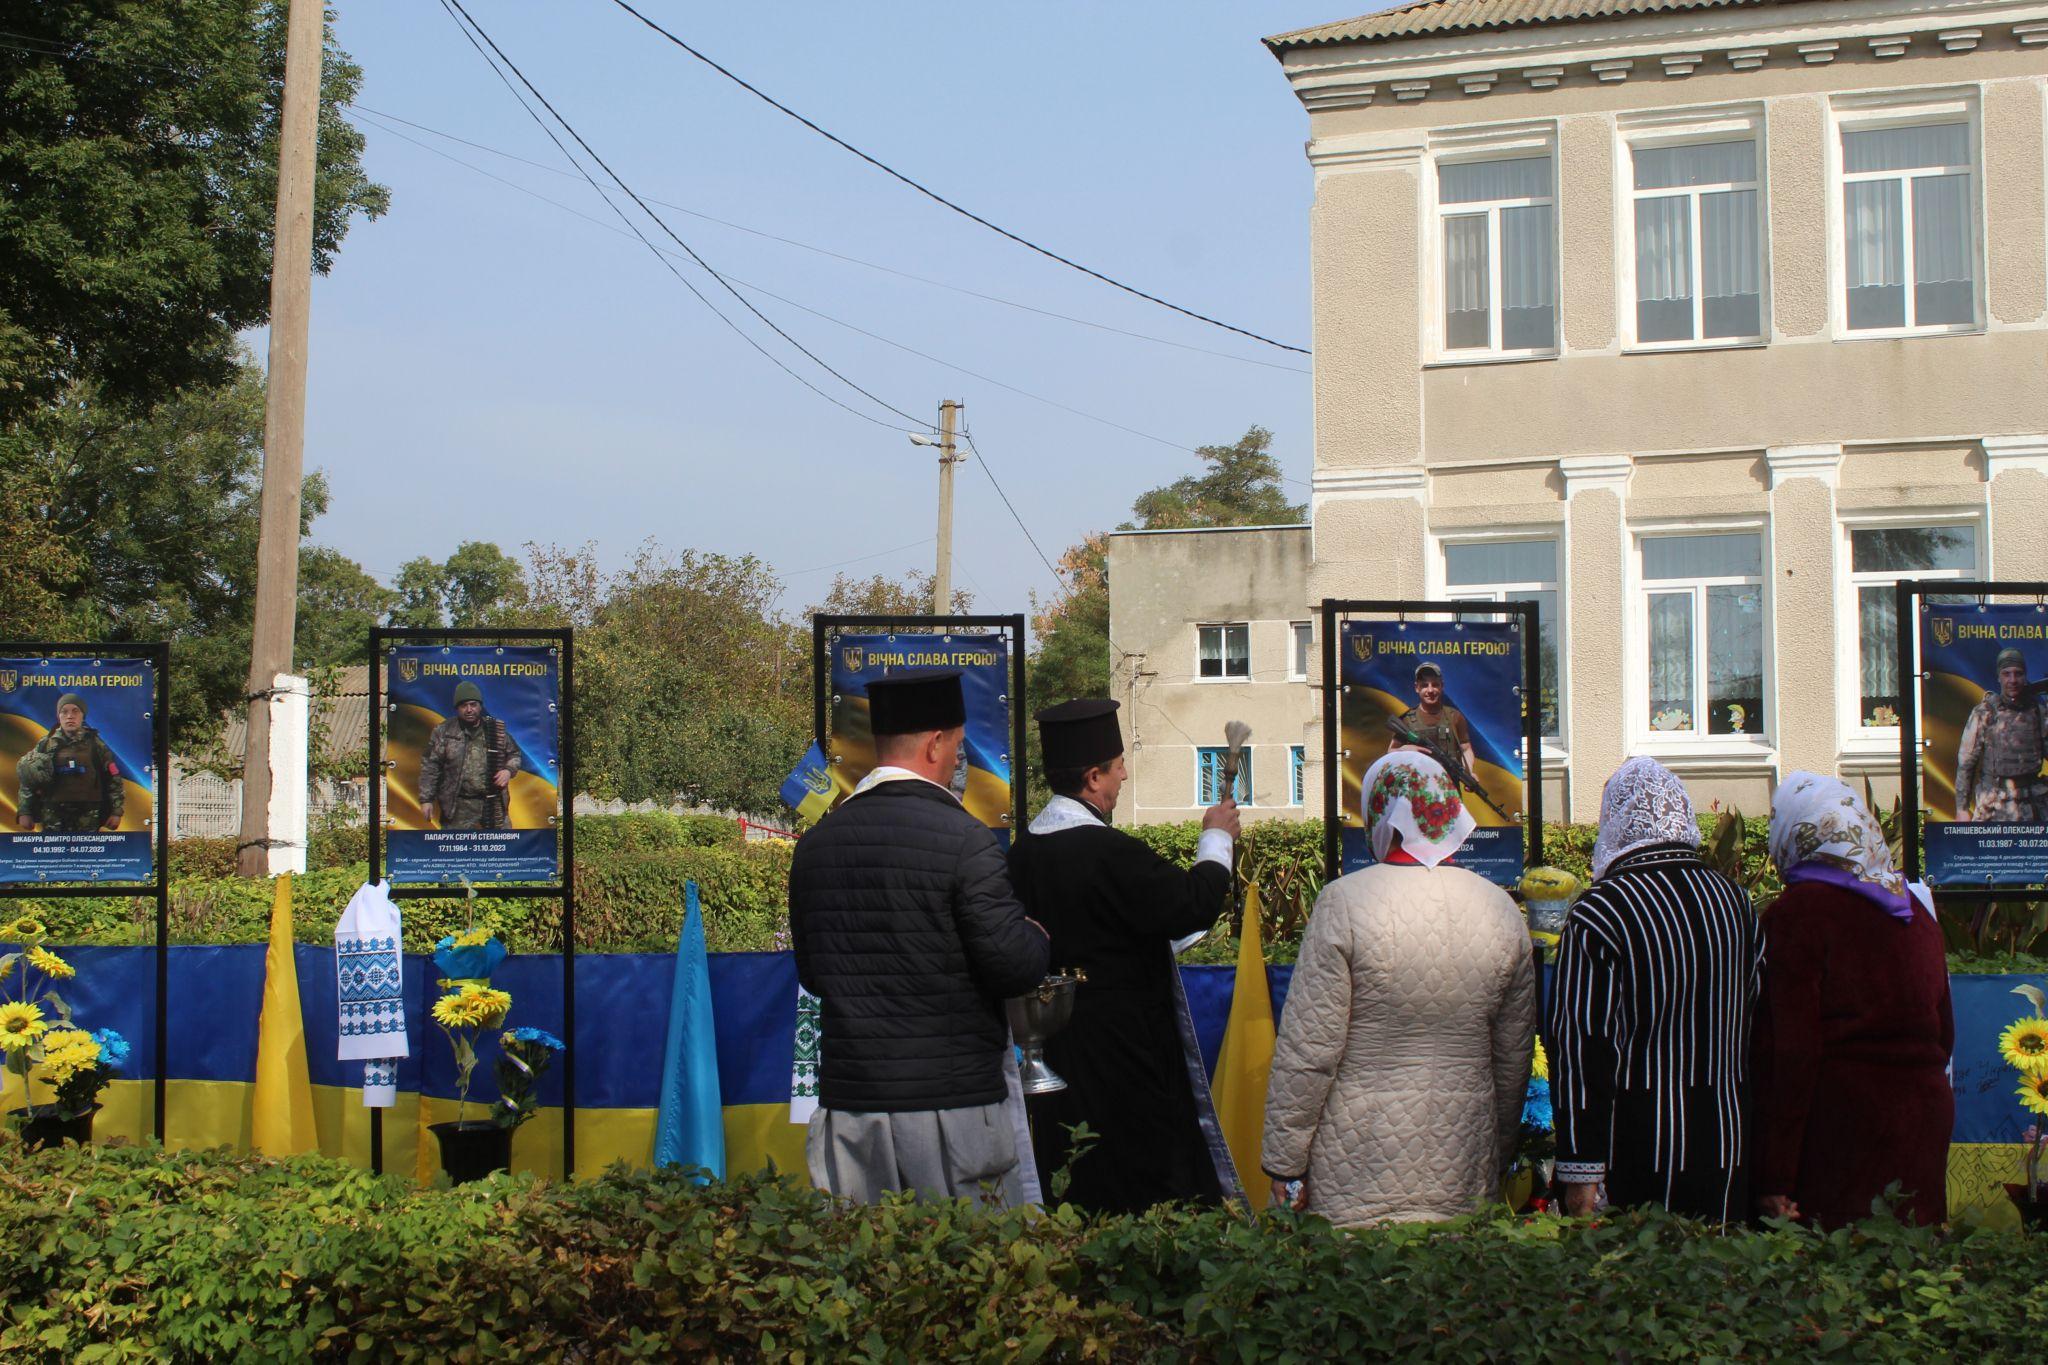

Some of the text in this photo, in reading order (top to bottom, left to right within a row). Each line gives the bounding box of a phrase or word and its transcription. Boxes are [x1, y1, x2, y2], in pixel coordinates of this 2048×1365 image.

[1958, 624, 1997, 639] ВІЧНА
[1999, 624, 2043, 639] СЛАВА
[1378, 641, 1509, 655] ВІЧНА СЛАВА ГЕРОЮ!
[868, 653, 997, 666] ВІЧНА СЛАВА ГЕРОЮ!
[423, 663, 547, 676] ВІЧНА СЛАВА ГЕРОЮ!
[22, 675, 143, 687] ВІЧНА СЛАВА ГЕРОЮ!
[1944, 825, 2002, 835] СТАНІШЕВСЬКИЙ
[2002, 826, 2045, 835] ОЛЕКСАНДР
[12, 835, 126, 843] ШКАБУРА ДМИТРО ОЛЕКСАНДРОВИЧ
[424, 831, 520, 841] ПАПАРУК СЕРГІЙ СТЕПАНОВИЧ
[438, 844, 468, 852] 17.11.1964
[473, 844, 506, 852] 31.10.2023
[1978, 840, 2013, 848] 11.03.1987
